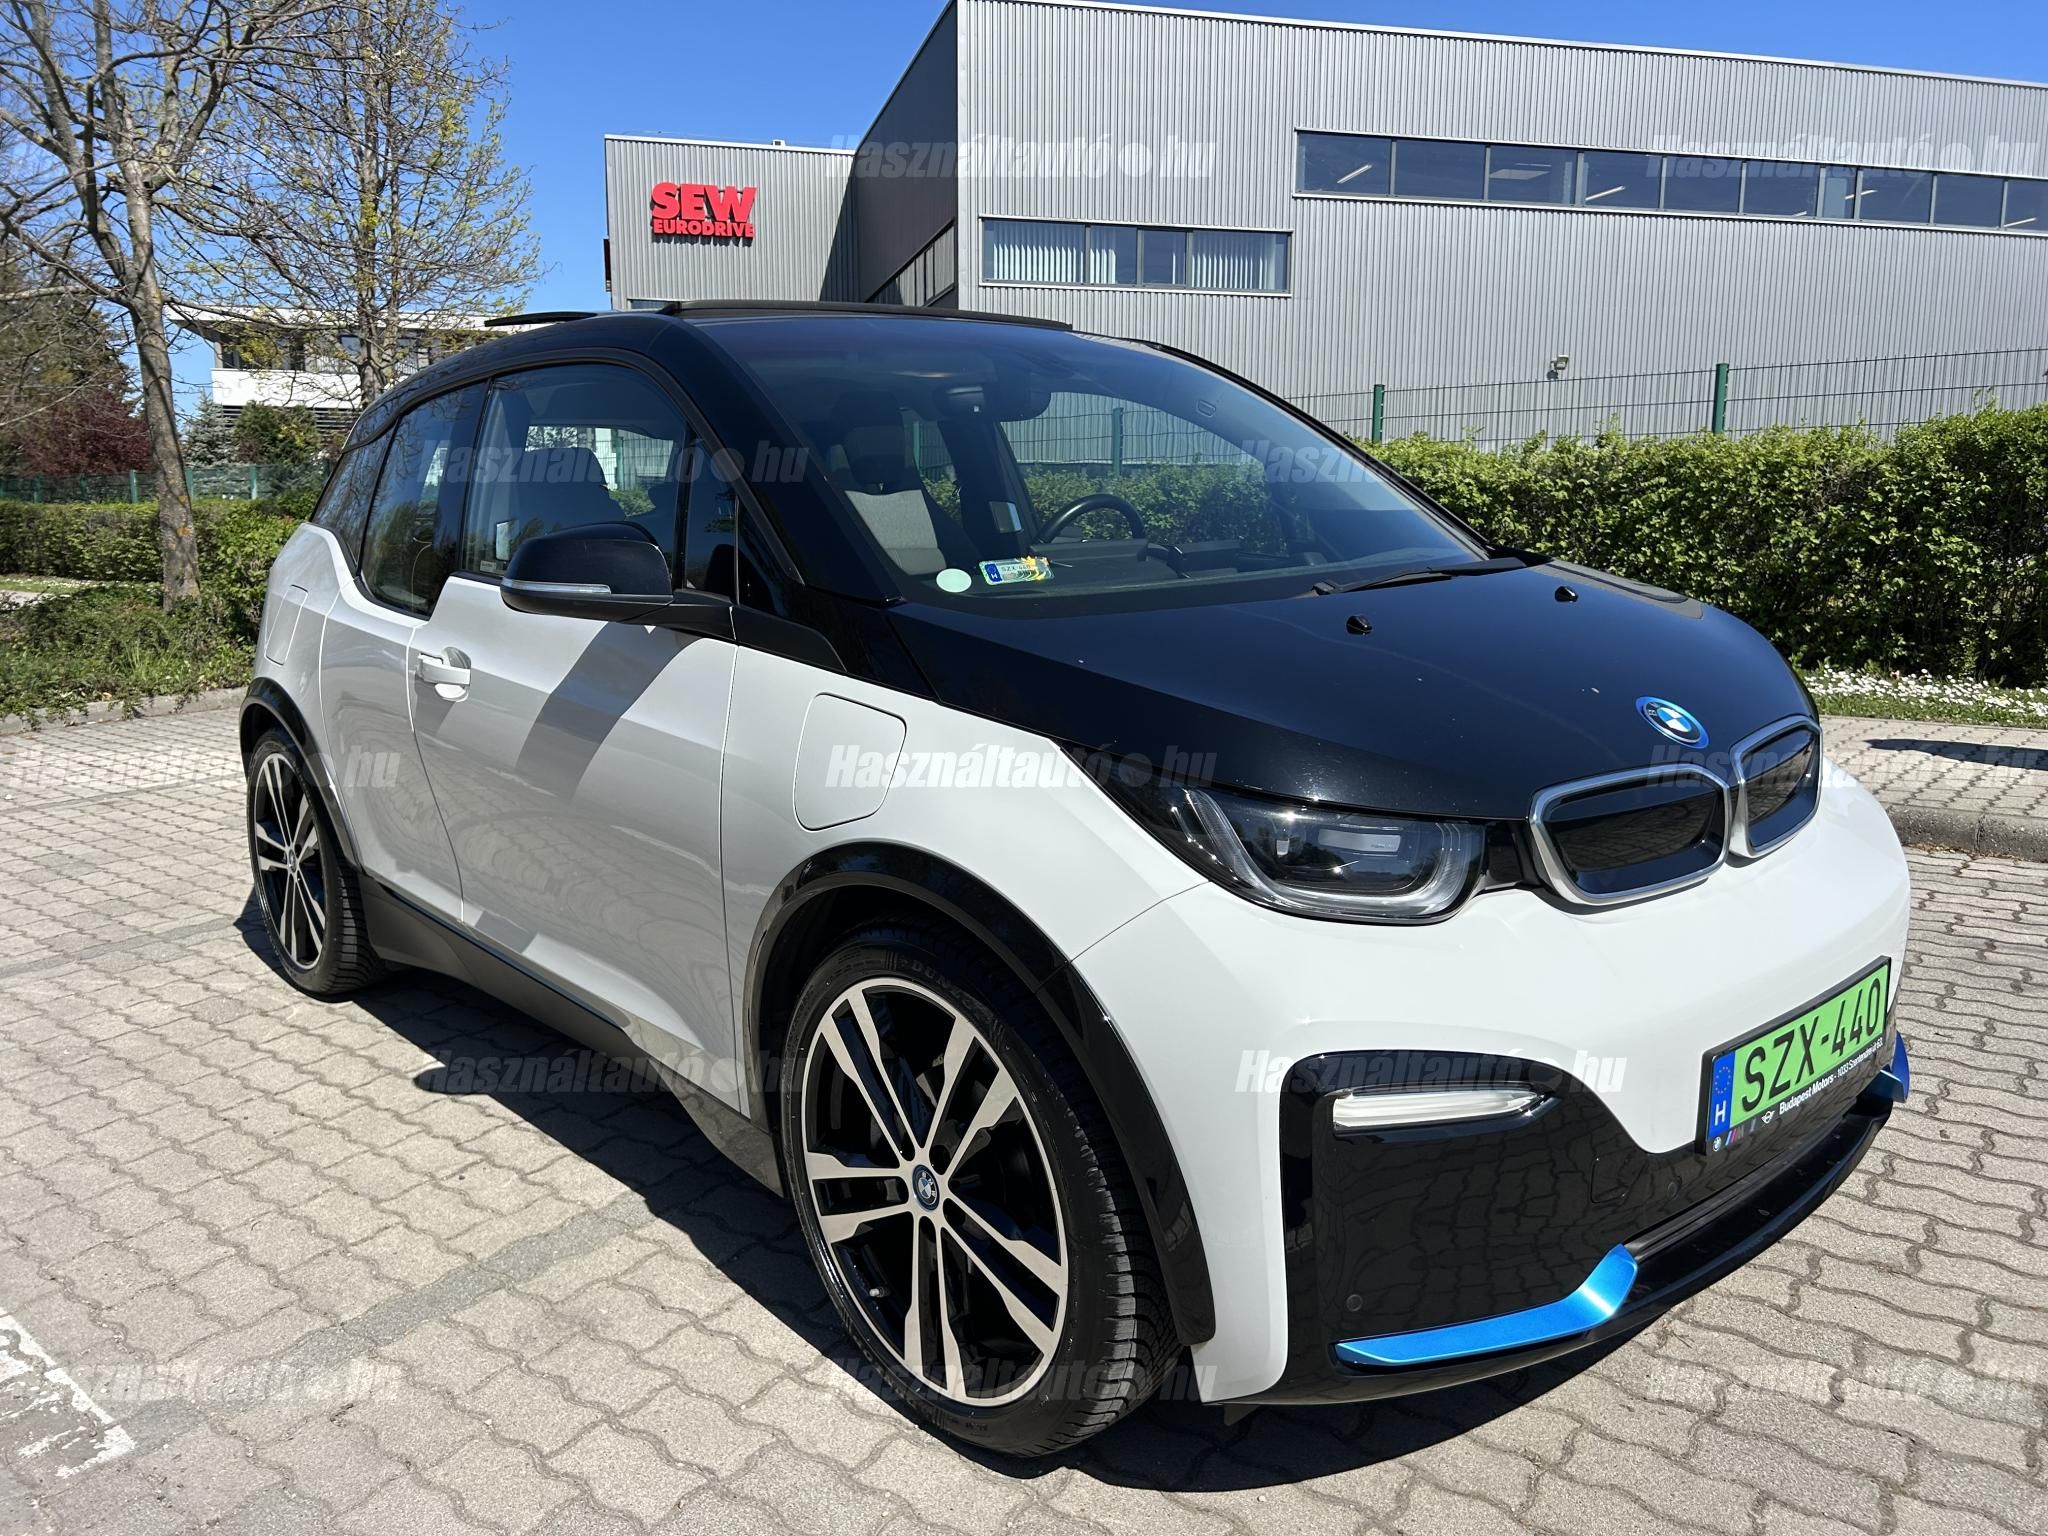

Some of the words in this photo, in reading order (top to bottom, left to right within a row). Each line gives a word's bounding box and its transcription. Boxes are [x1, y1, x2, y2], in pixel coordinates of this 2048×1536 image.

[652, 182, 757, 223] SEW
[653, 219, 754, 238] EURODRIVE
[1741, 977, 1881, 1112] SZX-440
[1714, 1100, 1726, 1126] H
[1779, 1087, 1812, 1115] Budapest
[1812, 1073, 1834, 1096] Motors
